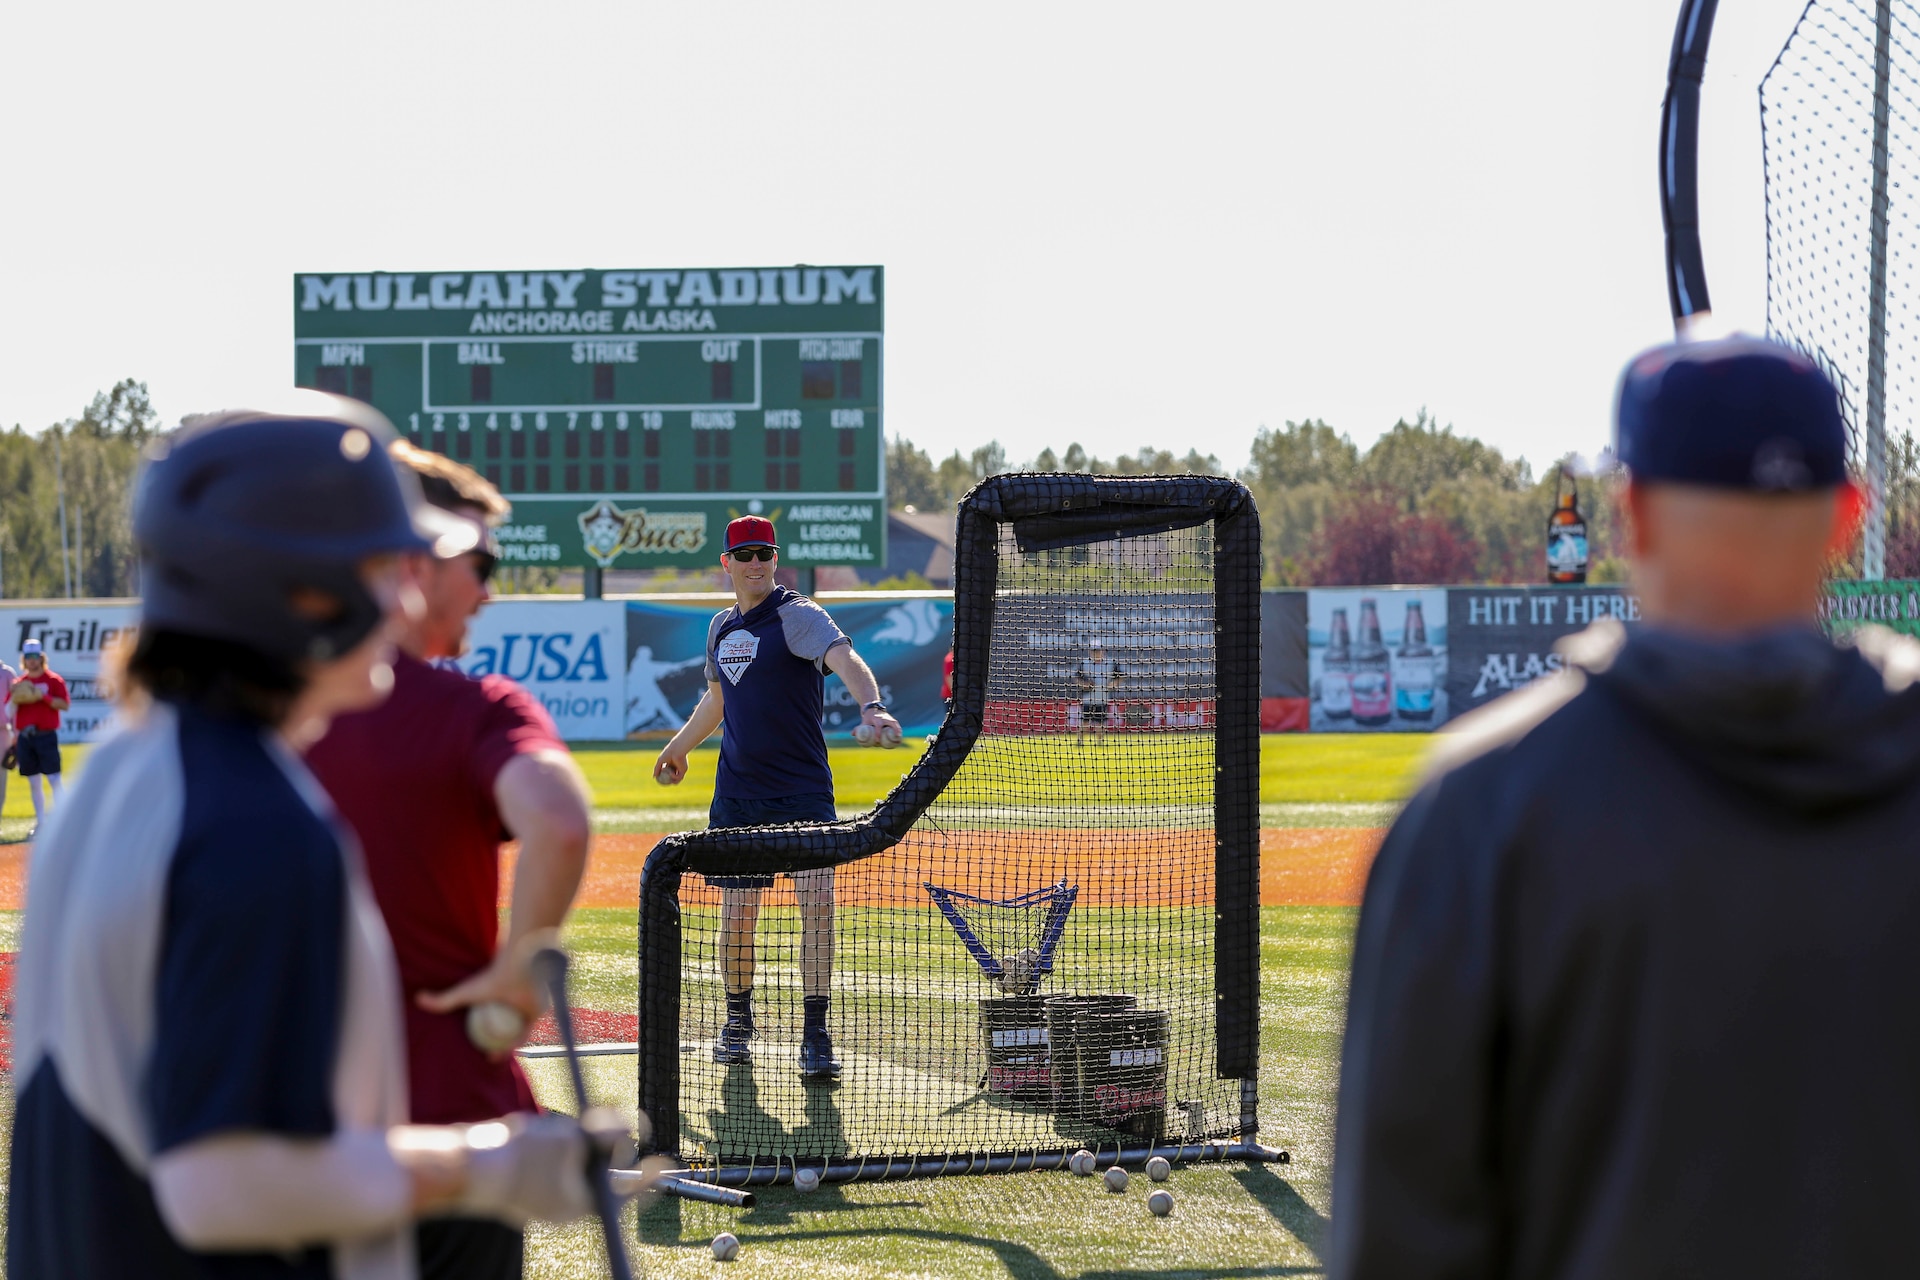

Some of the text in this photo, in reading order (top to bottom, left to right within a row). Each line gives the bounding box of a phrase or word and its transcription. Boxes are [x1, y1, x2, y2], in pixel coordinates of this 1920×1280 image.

[301, 268, 877, 311] MULCAHY STADIUM
[469, 309, 717, 333] ANCHORAGE ALASKA
[321, 344, 365, 366] MPH
[457, 342, 505, 364] BALL
[571, 342, 639, 364] STRIKE
[701, 340, 741, 362] OUT
[799, 339, 863, 360] PITCH COUNT
[409, 412, 662, 432] 1 2 3 4 5 6 7 8 9 10
[690, 410, 736, 430] RUNS
[764, 409, 801, 429] HITS
[830, 409, 864, 428] ERR
[788, 504, 873, 521] AMERICAN
[620, 512, 704, 550] Bucs
[800, 524, 861, 541] LEGION
[505, 544, 561, 561] PILOTS
[788, 544, 873, 560] BASEBALL
[1468, 594, 1642, 625] HIT IT HERE
